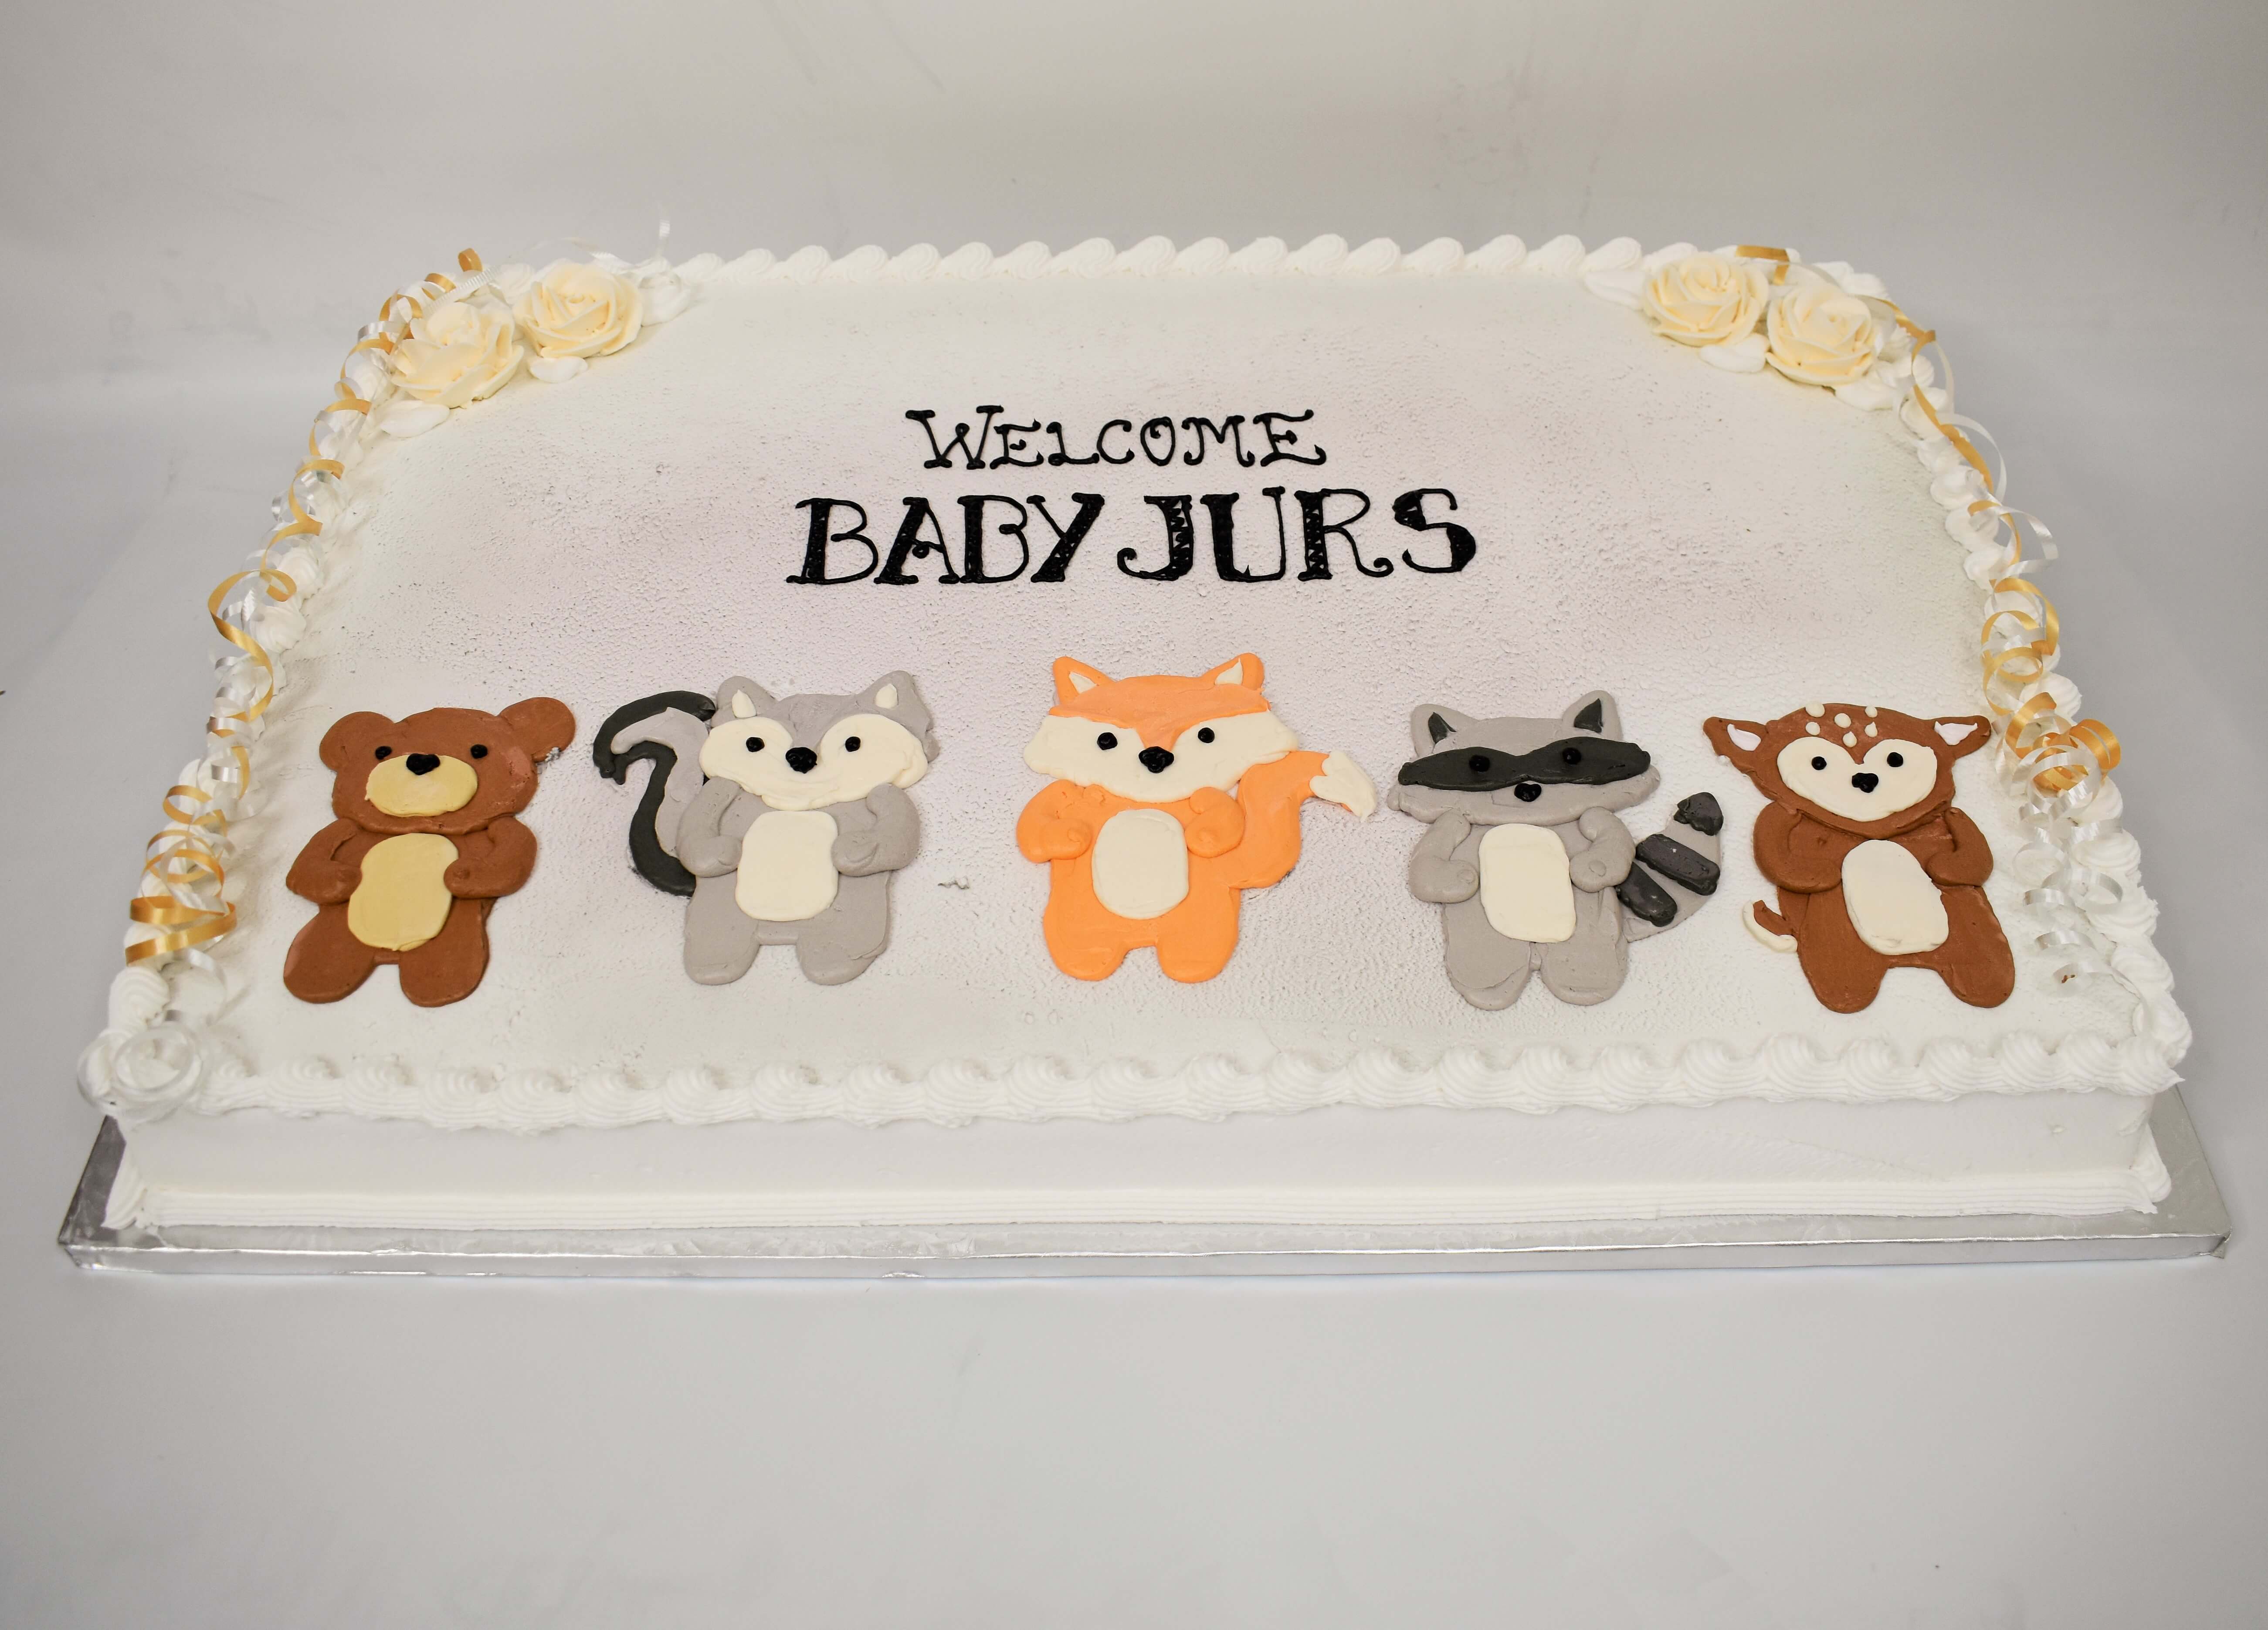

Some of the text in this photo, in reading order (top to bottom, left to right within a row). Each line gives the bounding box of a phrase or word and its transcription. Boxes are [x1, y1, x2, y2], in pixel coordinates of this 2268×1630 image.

[905, 404, 1327, 470] WELCOME
[785, 486, 1477, 586] BABY JURS
